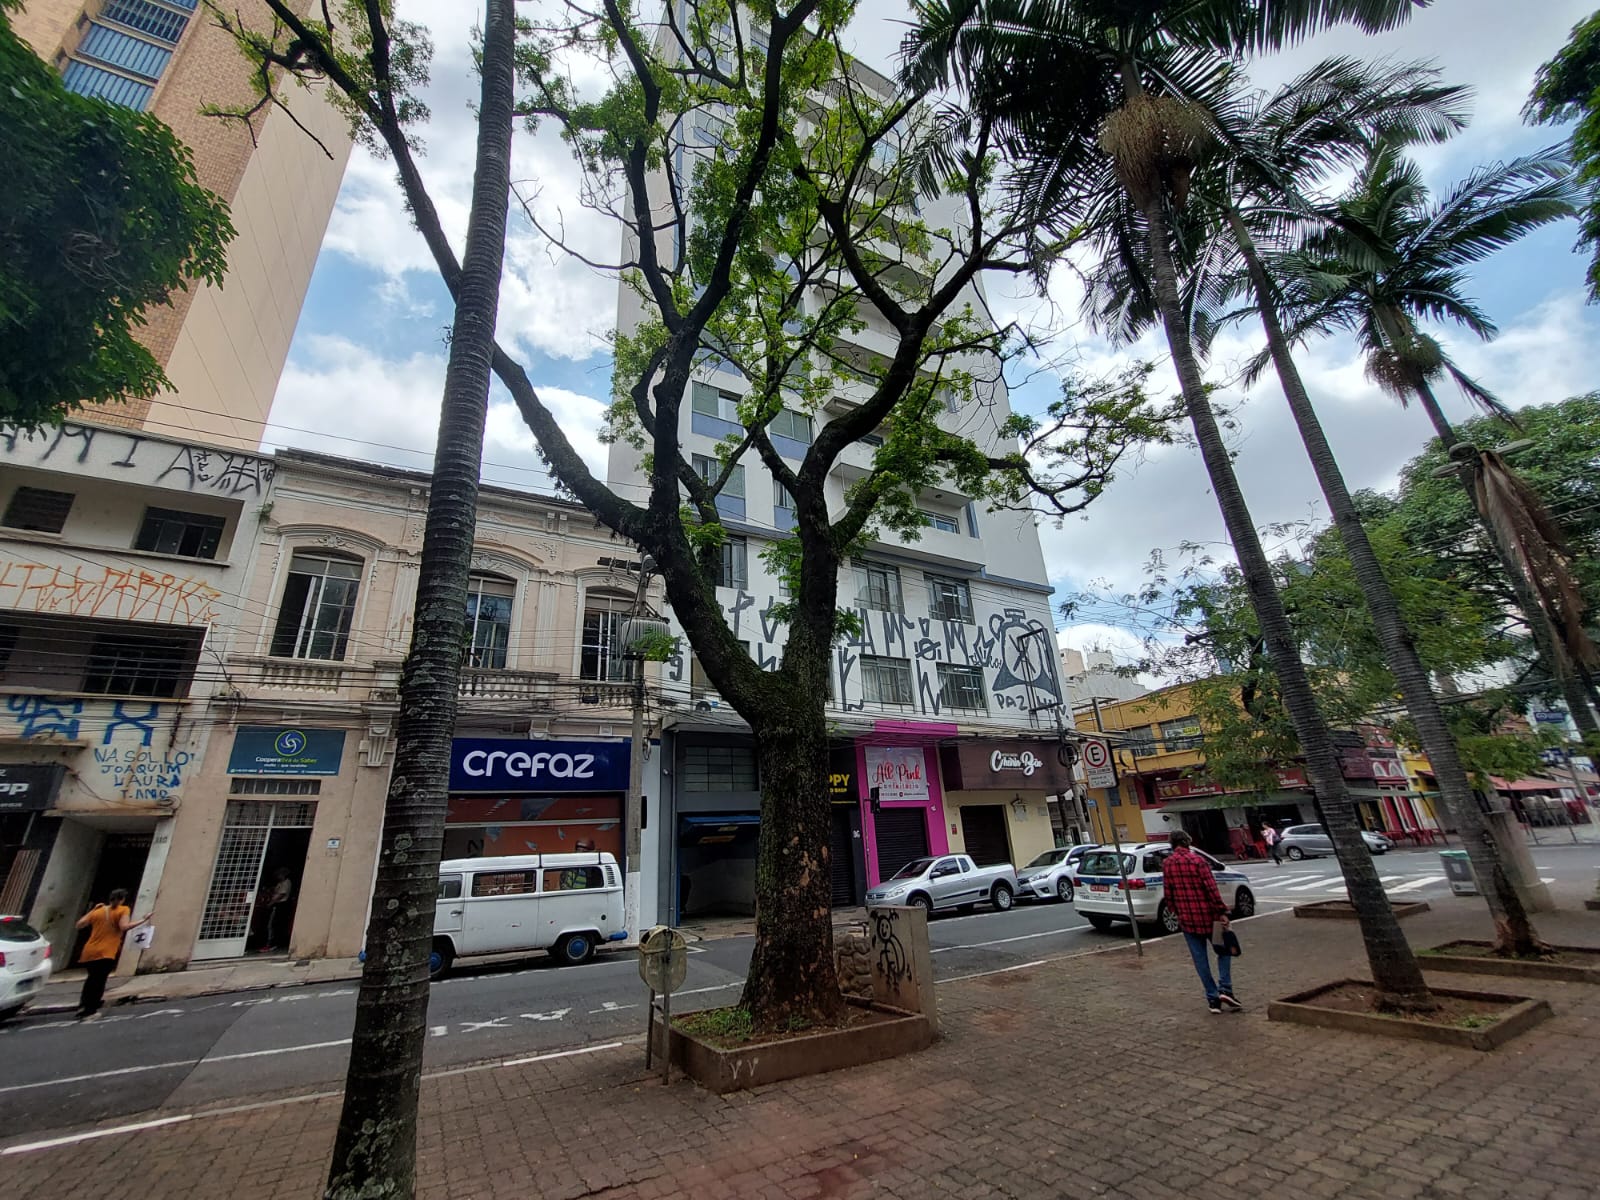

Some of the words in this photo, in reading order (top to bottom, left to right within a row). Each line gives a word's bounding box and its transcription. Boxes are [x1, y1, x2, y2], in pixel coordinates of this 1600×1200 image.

[1091, 747, 1101, 762] E
[101, 764, 181, 775] JOAQUIM
[462, 750, 595, 779] crefaz
[872, 761, 894, 783] All
[895, 763, 921, 782] Pink
